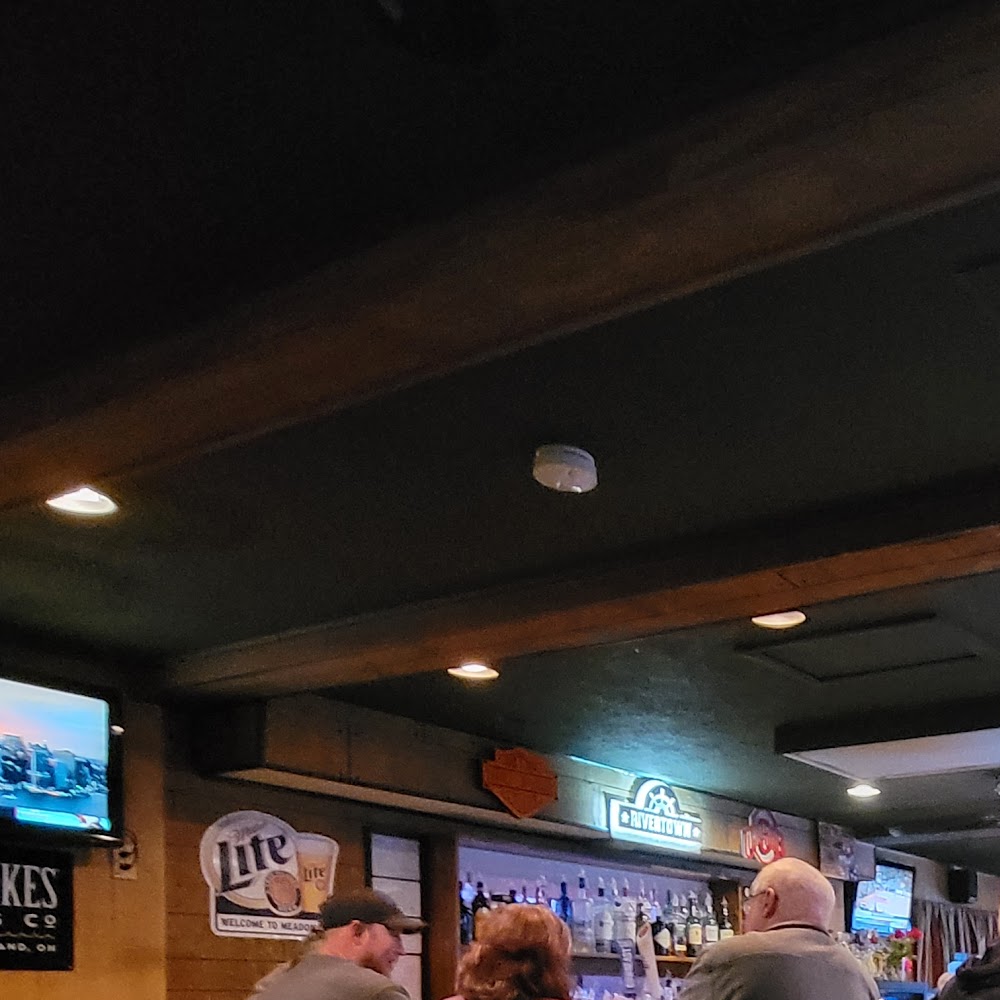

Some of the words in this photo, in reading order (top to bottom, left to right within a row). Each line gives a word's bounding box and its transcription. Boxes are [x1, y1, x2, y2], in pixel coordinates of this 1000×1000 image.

[630, 809, 693, 838] RIVERTOWN
[216, 834, 292, 893] Lite
[220, 917, 264, 929] WELCOME
[267, 920, 278, 930] TO
